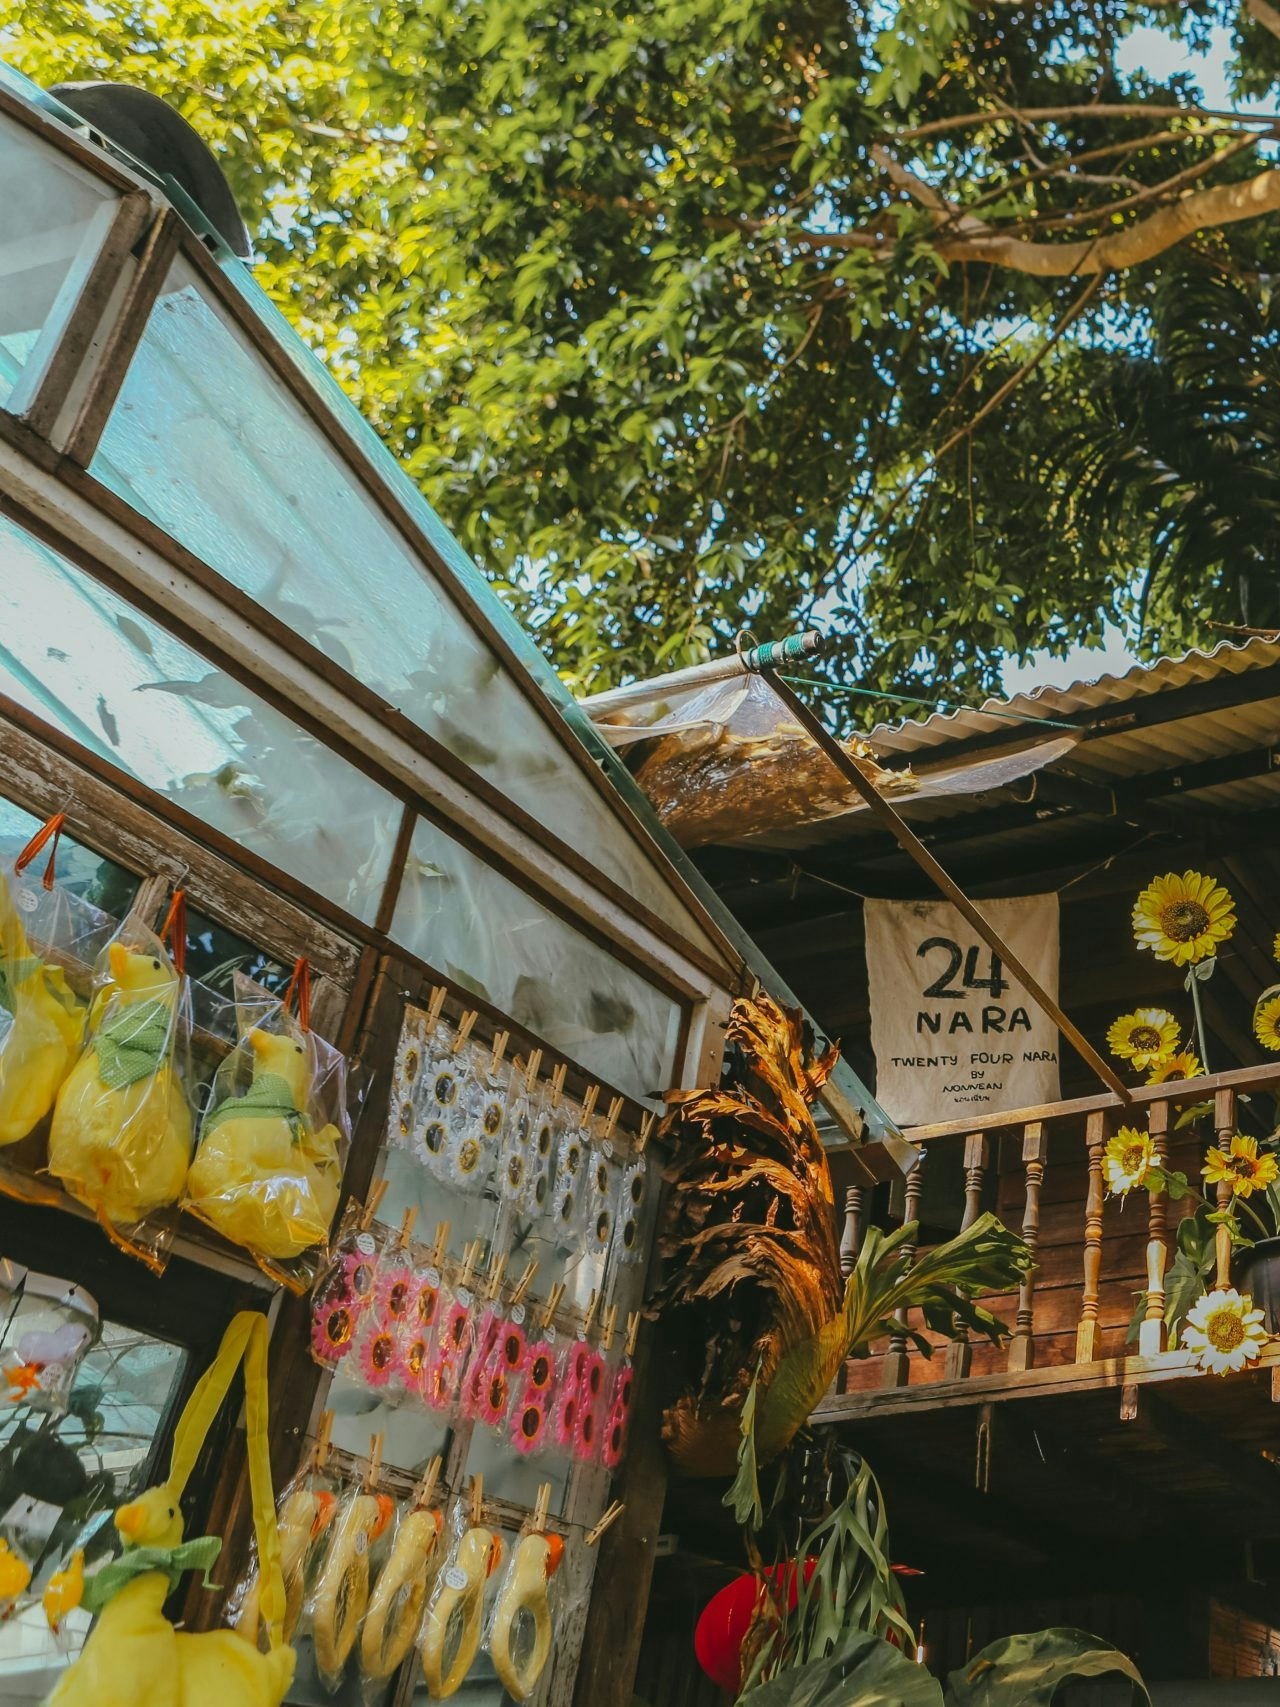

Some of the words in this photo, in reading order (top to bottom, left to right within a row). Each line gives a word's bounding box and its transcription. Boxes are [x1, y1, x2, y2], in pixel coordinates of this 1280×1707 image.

[916, 936, 1010, 999] 24
[916, 1005, 1033, 1034] NARA
[891, 1055, 958, 1068] TWENTY
[970, 1052, 1014, 1065] FOUR
[1023, 1050, 1058, 1064] NARA
[970, 1070, 985, 1079] BY
